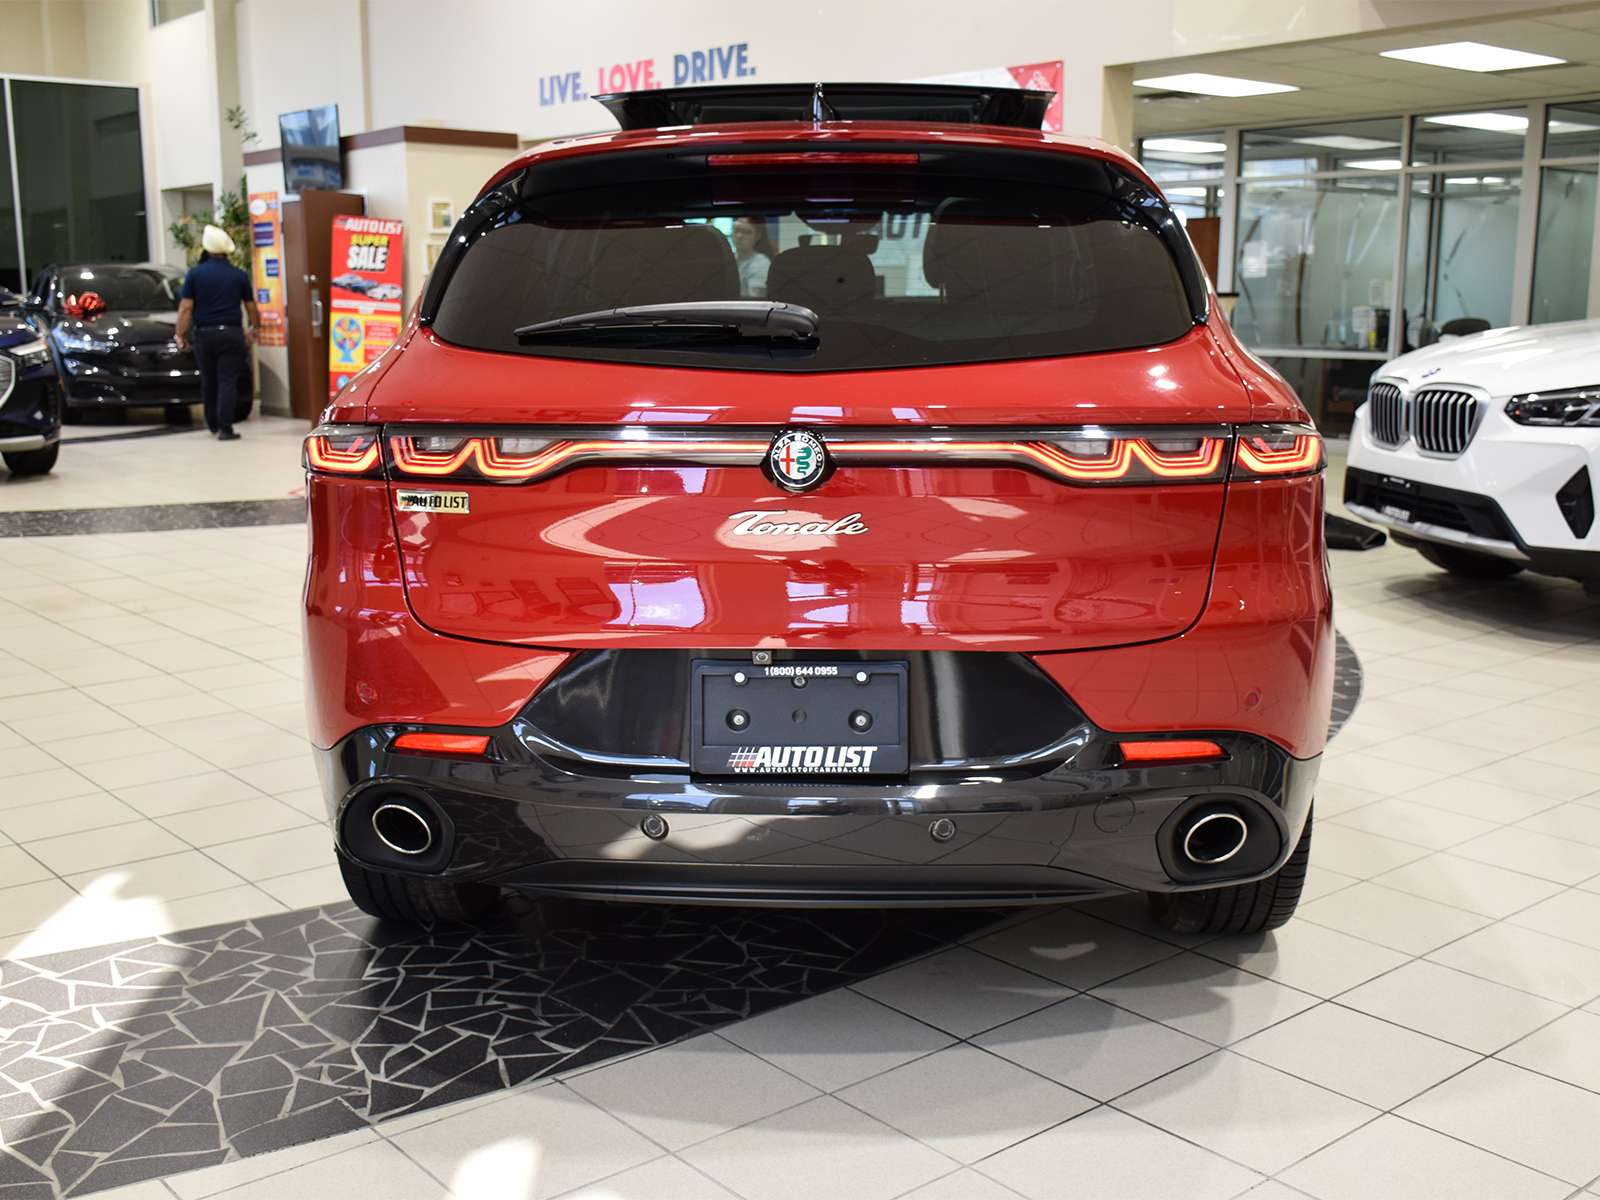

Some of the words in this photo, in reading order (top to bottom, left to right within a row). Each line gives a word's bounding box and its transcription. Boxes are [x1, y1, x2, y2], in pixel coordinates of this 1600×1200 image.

[539, 71, 587, 106] LIVE.
[597, 59, 662, 95] LOVE.
[673, 43, 756, 86] DRIVE.
[351, 233, 388, 246] SUPER
[347, 245, 388, 271] SALE
[728, 510, 869, 535] Tonale
[814, 666, 838, 675] 0955
